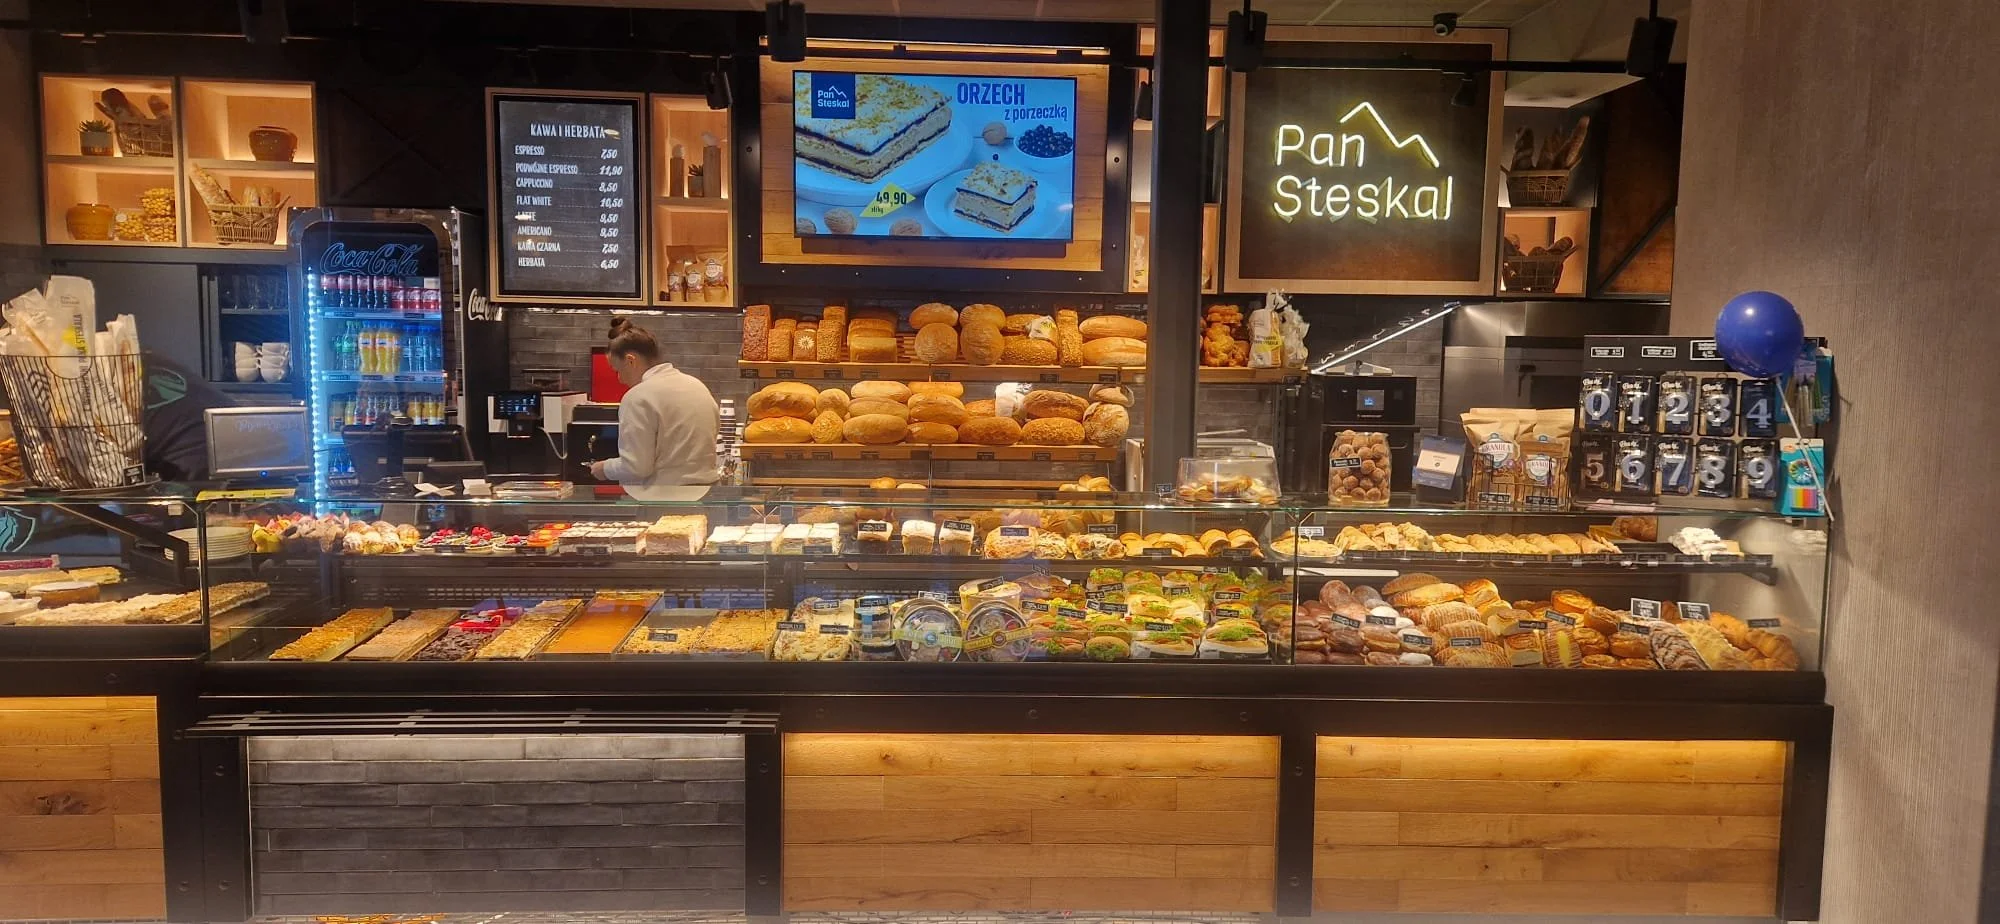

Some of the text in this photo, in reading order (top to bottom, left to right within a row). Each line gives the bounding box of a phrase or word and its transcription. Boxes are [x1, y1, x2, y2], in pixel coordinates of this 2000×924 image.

[817, 89, 834, 99] Pan
[957, 82, 1025, 106] ORZECH
[817, 98, 850, 108] Steskal
[1004, 103, 1068, 123] z porzeczką
[530, 123, 556, 136] KAWA
[564, 125, 606, 139] HERBATA
[515, 145, 545, 156] ESPRESSO
[1275, 124, 1365, 167] Pan
[601, 148, 618, 160] 7,50
[548, 164, 579, 175] ESPRESSO
[599, 165, 623, 176] 11,90
[515, 177, 553, 189] CAPPUCCINO
[516, 195, 552, 206] FLAT WHITE
[600, 198, 623, 208] 10,50
[876, 191, 907, 208] 49,90
[1273, 175, 1453, 220] Steskal
[517, 226, 552, 236] AMERICANO
[536, 241, 561, 252] CZARNA
[601, 243, 619, 254] 7,50
[321, 242, 425, 276] Coca-Cola
[518, 257, 545, 267] HERBATA
